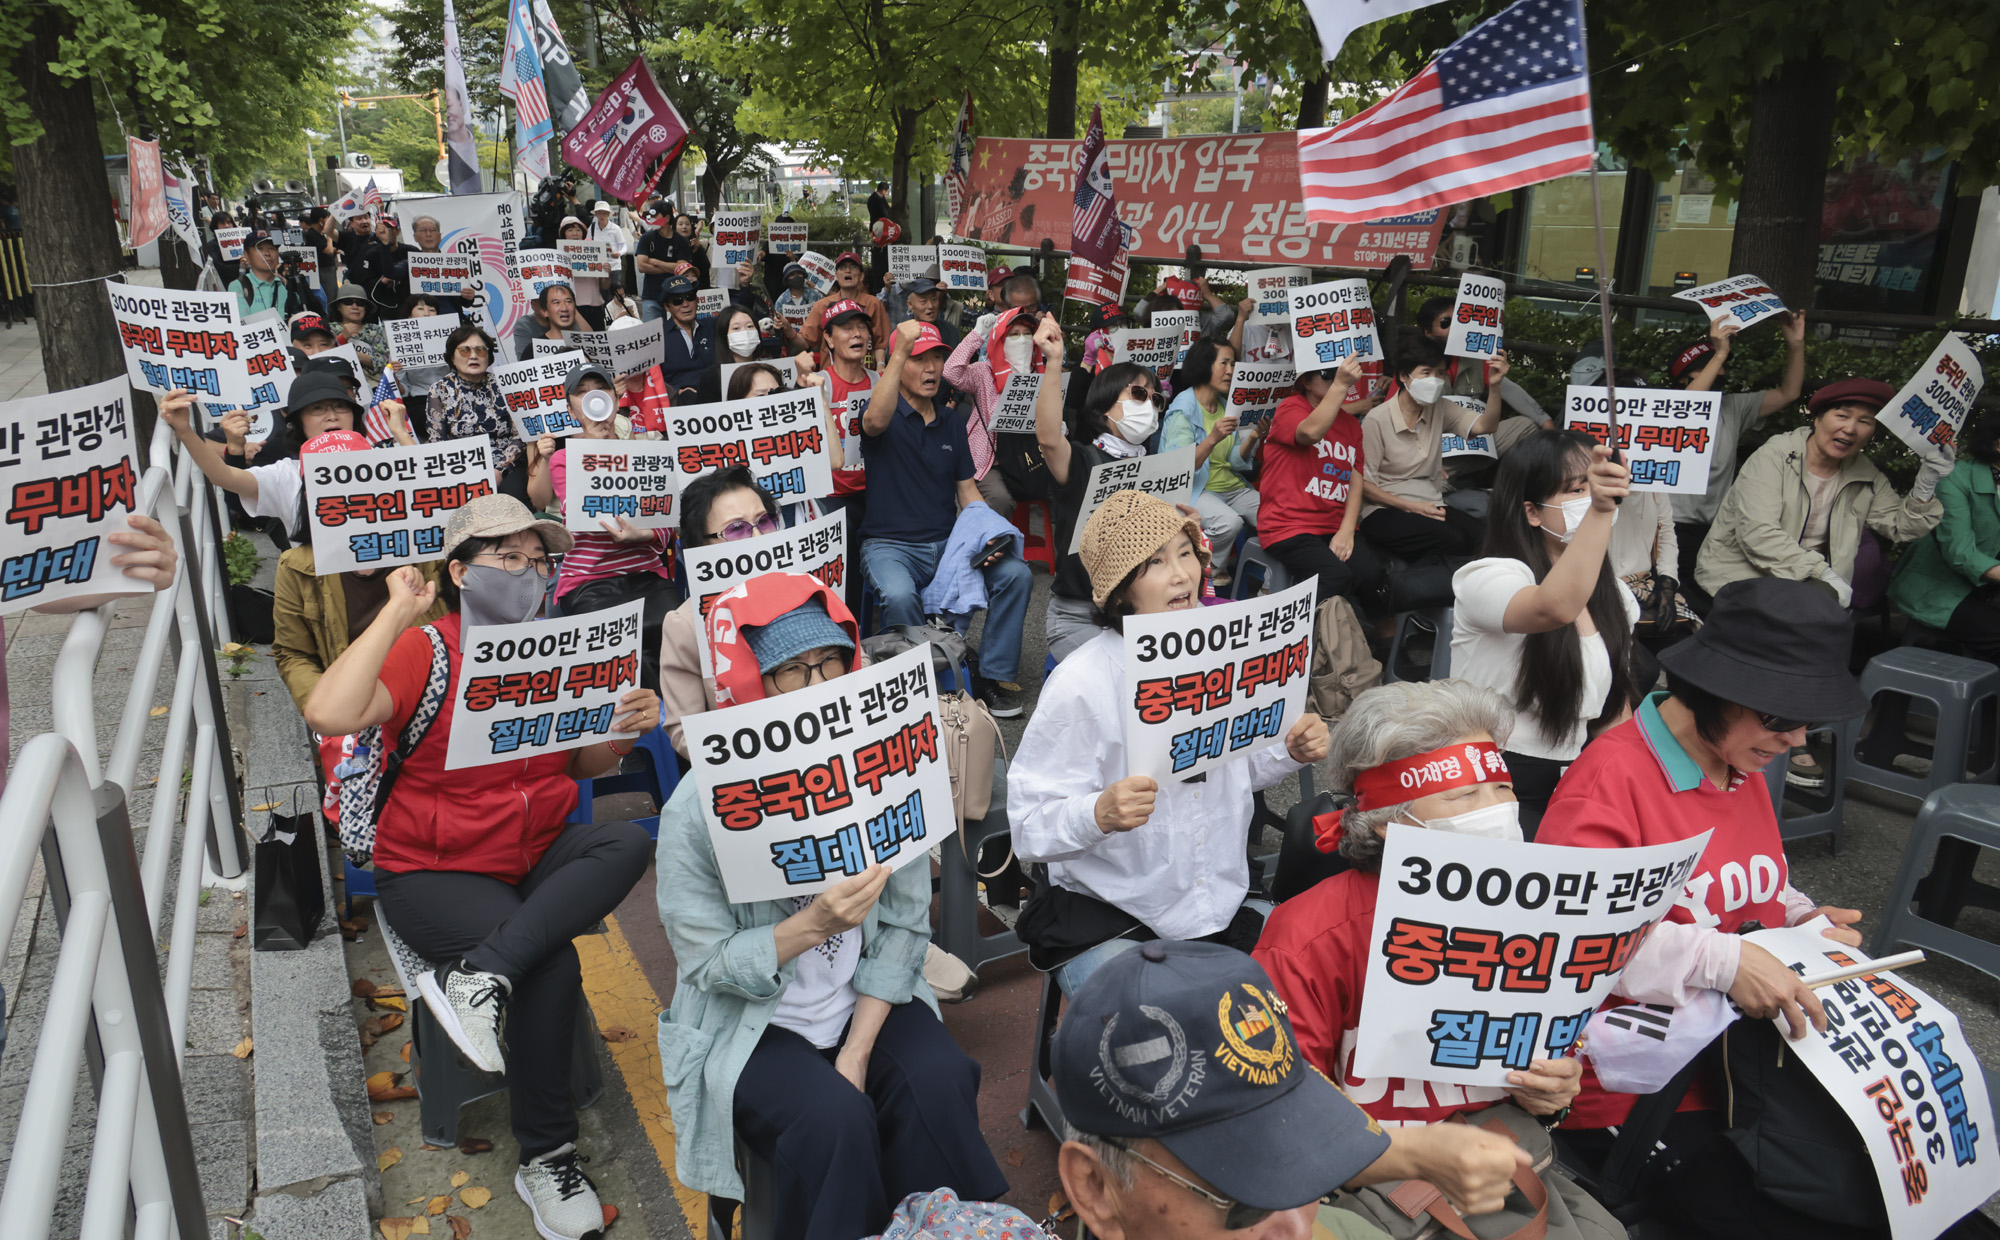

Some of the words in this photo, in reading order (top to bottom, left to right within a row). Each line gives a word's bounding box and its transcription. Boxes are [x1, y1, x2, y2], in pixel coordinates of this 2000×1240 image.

[1107, 142, 1187, 193] 무비자
[1195, 138, 1266, 192] 입국
[717, 216, 749, 227] 3000만
[987, 207, 1012, 229] PASSED
[1157, 202, 1234, 252] 아닌
[1241, 199, 1349, 260] 점령?
[563, 245, 583, 253] 중국인
[716, 231, 746, 246] 중국인
[1358, 231, 1431, 250] 6.3대선무효
[411, 256, 443, 265] 3000만
[446, 257, 468, 265] 관광객
[520, 253, 554, 264] 3000만
[572, 253, 599, 261] 000만명
[725, 249, 746, 264] 절대
[892, 255, 911, 263] 관광객
[942, 249, 970, 258] 3000만
[1354, 250, 1378, 262] STOP
[411, 267, 440, 279] 중국인
[441, 267, 469, 279] 무비자
[521, 265, 553, 279] 중국인
[588, 263, 603, 272] 반대
[942, 260, 968, 272] 중국인
[421, 282, 441, 292] 절대
[442, 282, 462, 293] 반대
[951, 274, 969, 286] 절대
[969, 275, 985, 287] 반대
[1066, 278, 1097, 292] SECURITY
[1098, 286, 1119, 301] THREAT
[1257, 276, 1286, 289] 중국인
[111, 293, 167, 319] 3000만
[172, 301, 232, 323] 관광객
[1295, 287, 1351, 310] 3000만
[1154, 316, 1193, 327] 3000만
[1296, 309, 1349, 337] 중국인
[1457, 303, 1498, 328] 중국인
[1730, 301, 1770, 322] 절대
[390, 320, 419, 332] 중국인
[392, 330, 422, 343] 관광객
[118, 320, 165, 356] 중국인
[166, 329, 239, 360] 무비자
[242, 327, 277, 349] 광객
[395, 343, 424, 354] 자국민
[570, 333, 608, 345] 중국인
[614, 332, 662, 355] 유치보다
[1126, 338, 1155, 351] 중국인
[1316, 337, 1353, 363] 절대
[1353, 335, 1373, 357] 반대
[1465, 331, 1496, 355] 절대
[246, 349, 287, 376] 비자
[397, 355, 427, 367] 안전이
[1128, 349, 1175, 363] 3000만명
[139, 359, 171, 391] 절대
[171, 367, 221, 396] 반대
[498, 366, 538, 387] 3000만
[1012, 375, 1039, 388] 중국인
[1237, 370, 1282, 383] 3000만
[1935, 353, 1968, 390] 중국인
[505, 388, 538, 412] 중국인
[1007, 389, 1035, 402] 관광객
[1232, 387, 1270, 405] 중국인
[1926, 379, 1965, 425] 3000만명
[672, 406, 754, 437] 3000만
[758, 396, 818, 432] 관광객
[1001, 404, 1030, 416] 자국민
[1239, 409, 1263, 426] 절대
[1571, 396, 1648, 417] 3000만
[1651, 398, 1713, 421] 관광객
[1900, 393, 1941, 436] 무비자
[36, 397, 127, 461] 관광객
[522, 414, 546, 436] 절대
[996, 418, 1025, 429] 안전이
[310, 434, 331, 450] STOP
[333, 432, 353, 442] THE
[318, 443, 351, 454] STEAL
[678, 440, 750, 475] 중국인
[751, 426, 823, 467] 무비자
[1635, 425, 1710, 454] 무비자
[314, 457, 417, 485] 3000만
[424, 446, 487, 479] 관광객
[581, 454, 628, 472] 중국인
[632, 453, 674, 473] 관광객
[1099, 461, 1142, 484] 중국인
[1631, 459, 1681, 486] 반대
[590, 475, 666, 492] 3000만명
[758, 465, 806, 500] 반대
[1138, 471, 1190, 495] 유치보다
[6, 455, 139, 536] 무비자
[582, 494, 638, 518] 무비자
[639, 494, 673, 517] 반대
[316, 490, 407, 527] 중국인
[349, 529, 410, 563] 절대
[695, 541, 794, 583] 3000만
[797, 520, 843, 564] 관광객
[1, 536, 101, 601] 반대
[1136, 618, 1252, 663] 3000만
[1257, 592, 1312, 642] 관광객
[474, 629, 581, 664] 3000만
[585, 616, 639, 654] 관광객
[464, 666, 562, 712] 중국인
[563, 649, 638, 697] 무비자
[1134, 662, 1233, 724] 중국인
[1237, 635, 1309, 698] 무비자
[702, 697, 854, 767] 3000만
[859, 661, 930, 727] 관광객
[489, 705, 551, 755] 절대
[555, 701, 615, 742] 반대
[1170, 718, 1227, 774] 절대
[1230, 698, 1286, 750] 반대
[712, 754, 855, 831] 중국인
[854, 711, 938, 796] 무비자
[1400, 756, 1462, 788] 이재명
[770, 822, 868, 885] 절대
[866, 788, 926, 864] 반대
[1397, 856, 1598, 916] 3000만
[1605, 851, 1698, 915] 관광객
[1383, 917, 1560, 994] 중국인
[1427, 1008, 1542, 1070] 절대
[1215, 1042, 1278, 1086] VIETNAM
[1089, 1066, 1147, 1125] VIETNAM
[1151, 1050, 1207, 1124] VETERAN
[1908, 1020, 1979, 1168] 무비자
[1864, 1073, 1930, 1207] 중국인
